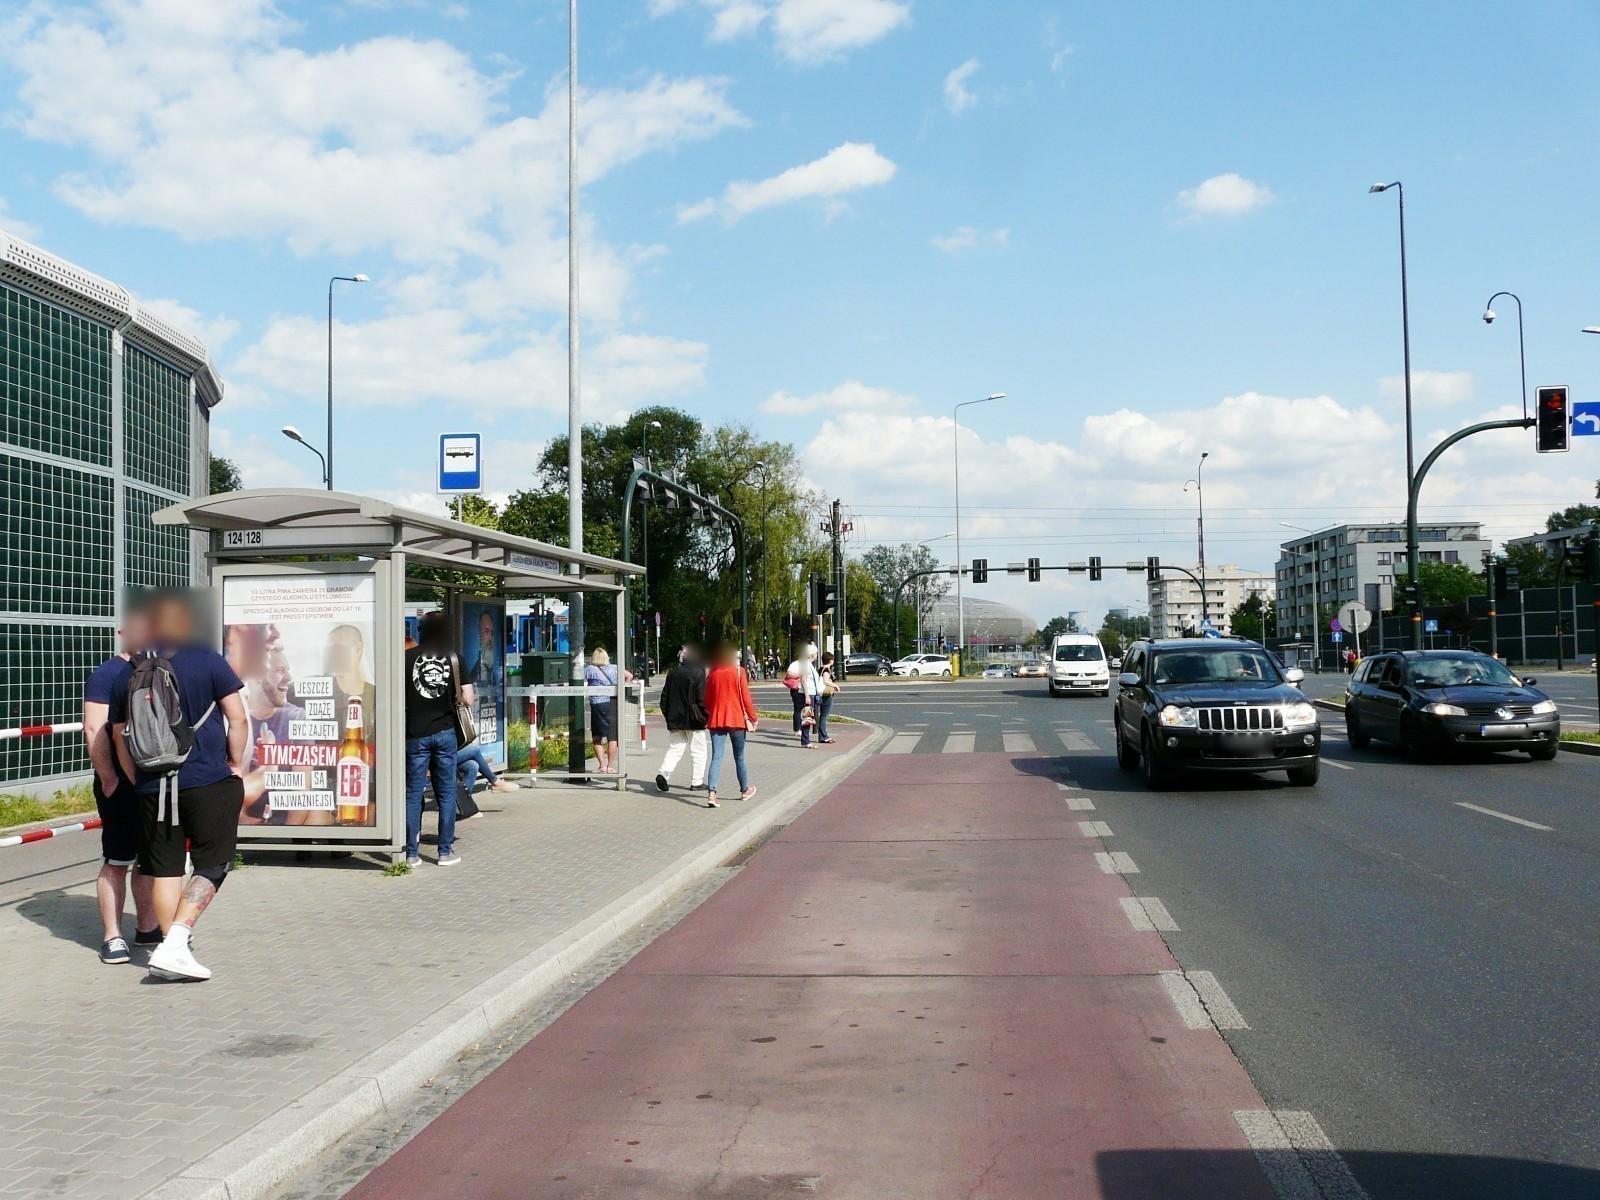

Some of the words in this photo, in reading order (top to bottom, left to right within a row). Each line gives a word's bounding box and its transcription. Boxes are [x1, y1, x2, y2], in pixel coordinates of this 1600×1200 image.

[228, 532, 243, 544] 124
[246, 531, 261, 544] 128
[297, 681, 329, 695] JESZCZE
[349, 705, 358, 720] EB
[263, 744, 337, 766] TYMCZASEM
[265, 773, 303, 787] ZNAJOMI
[341, 764, 362, 797] EB
